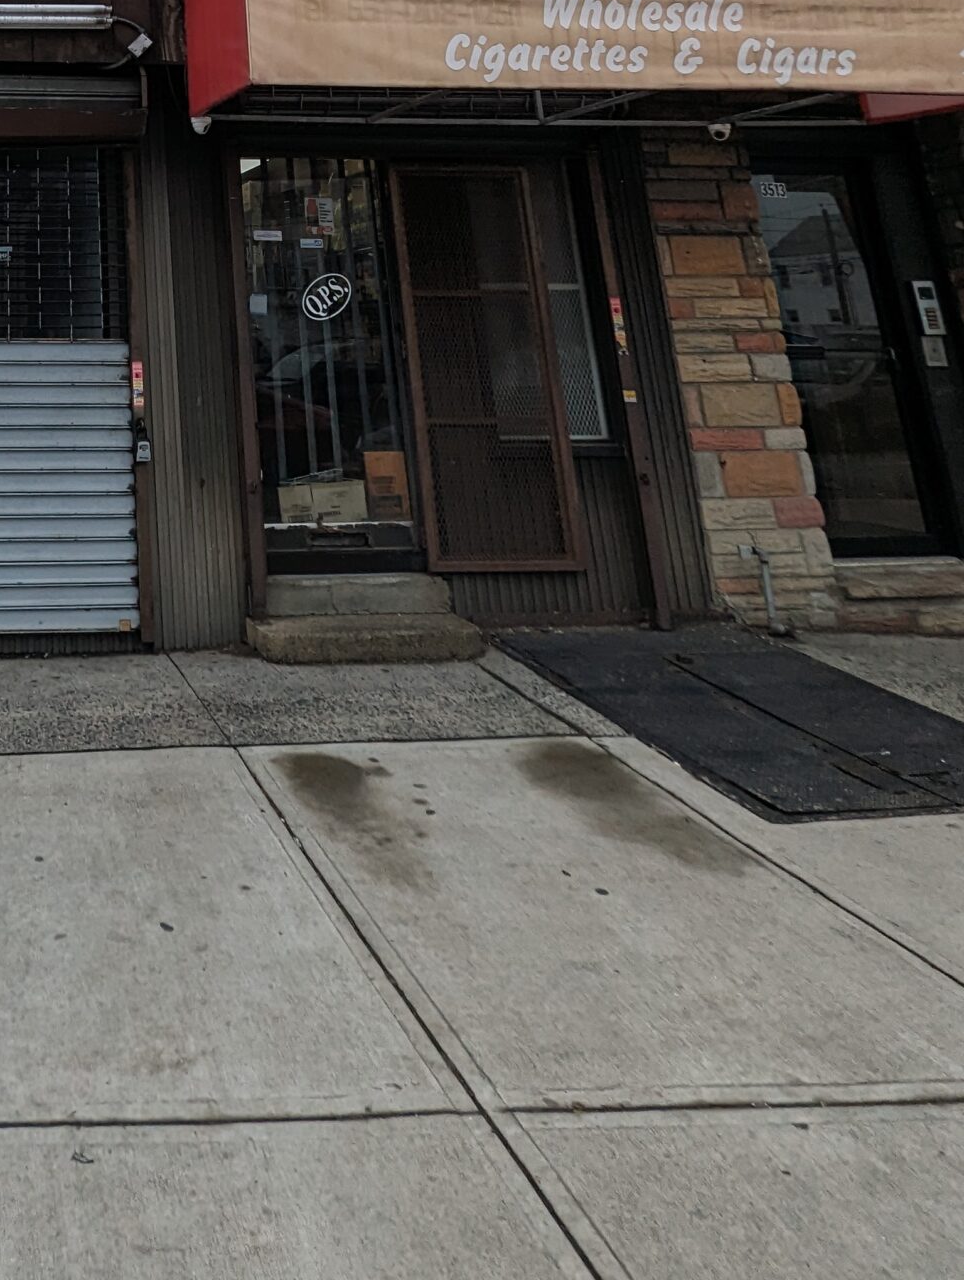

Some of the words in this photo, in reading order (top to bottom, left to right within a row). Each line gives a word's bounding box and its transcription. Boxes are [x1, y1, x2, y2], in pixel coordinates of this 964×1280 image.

[445, 33, 649, 83] Cigarettes
[673, 37, 704, 74] &
[737, 37, 856, 85] Cigars
[761, 182, 786, 197] 3513
[306, 278, 348, 317] Q.P.S.
